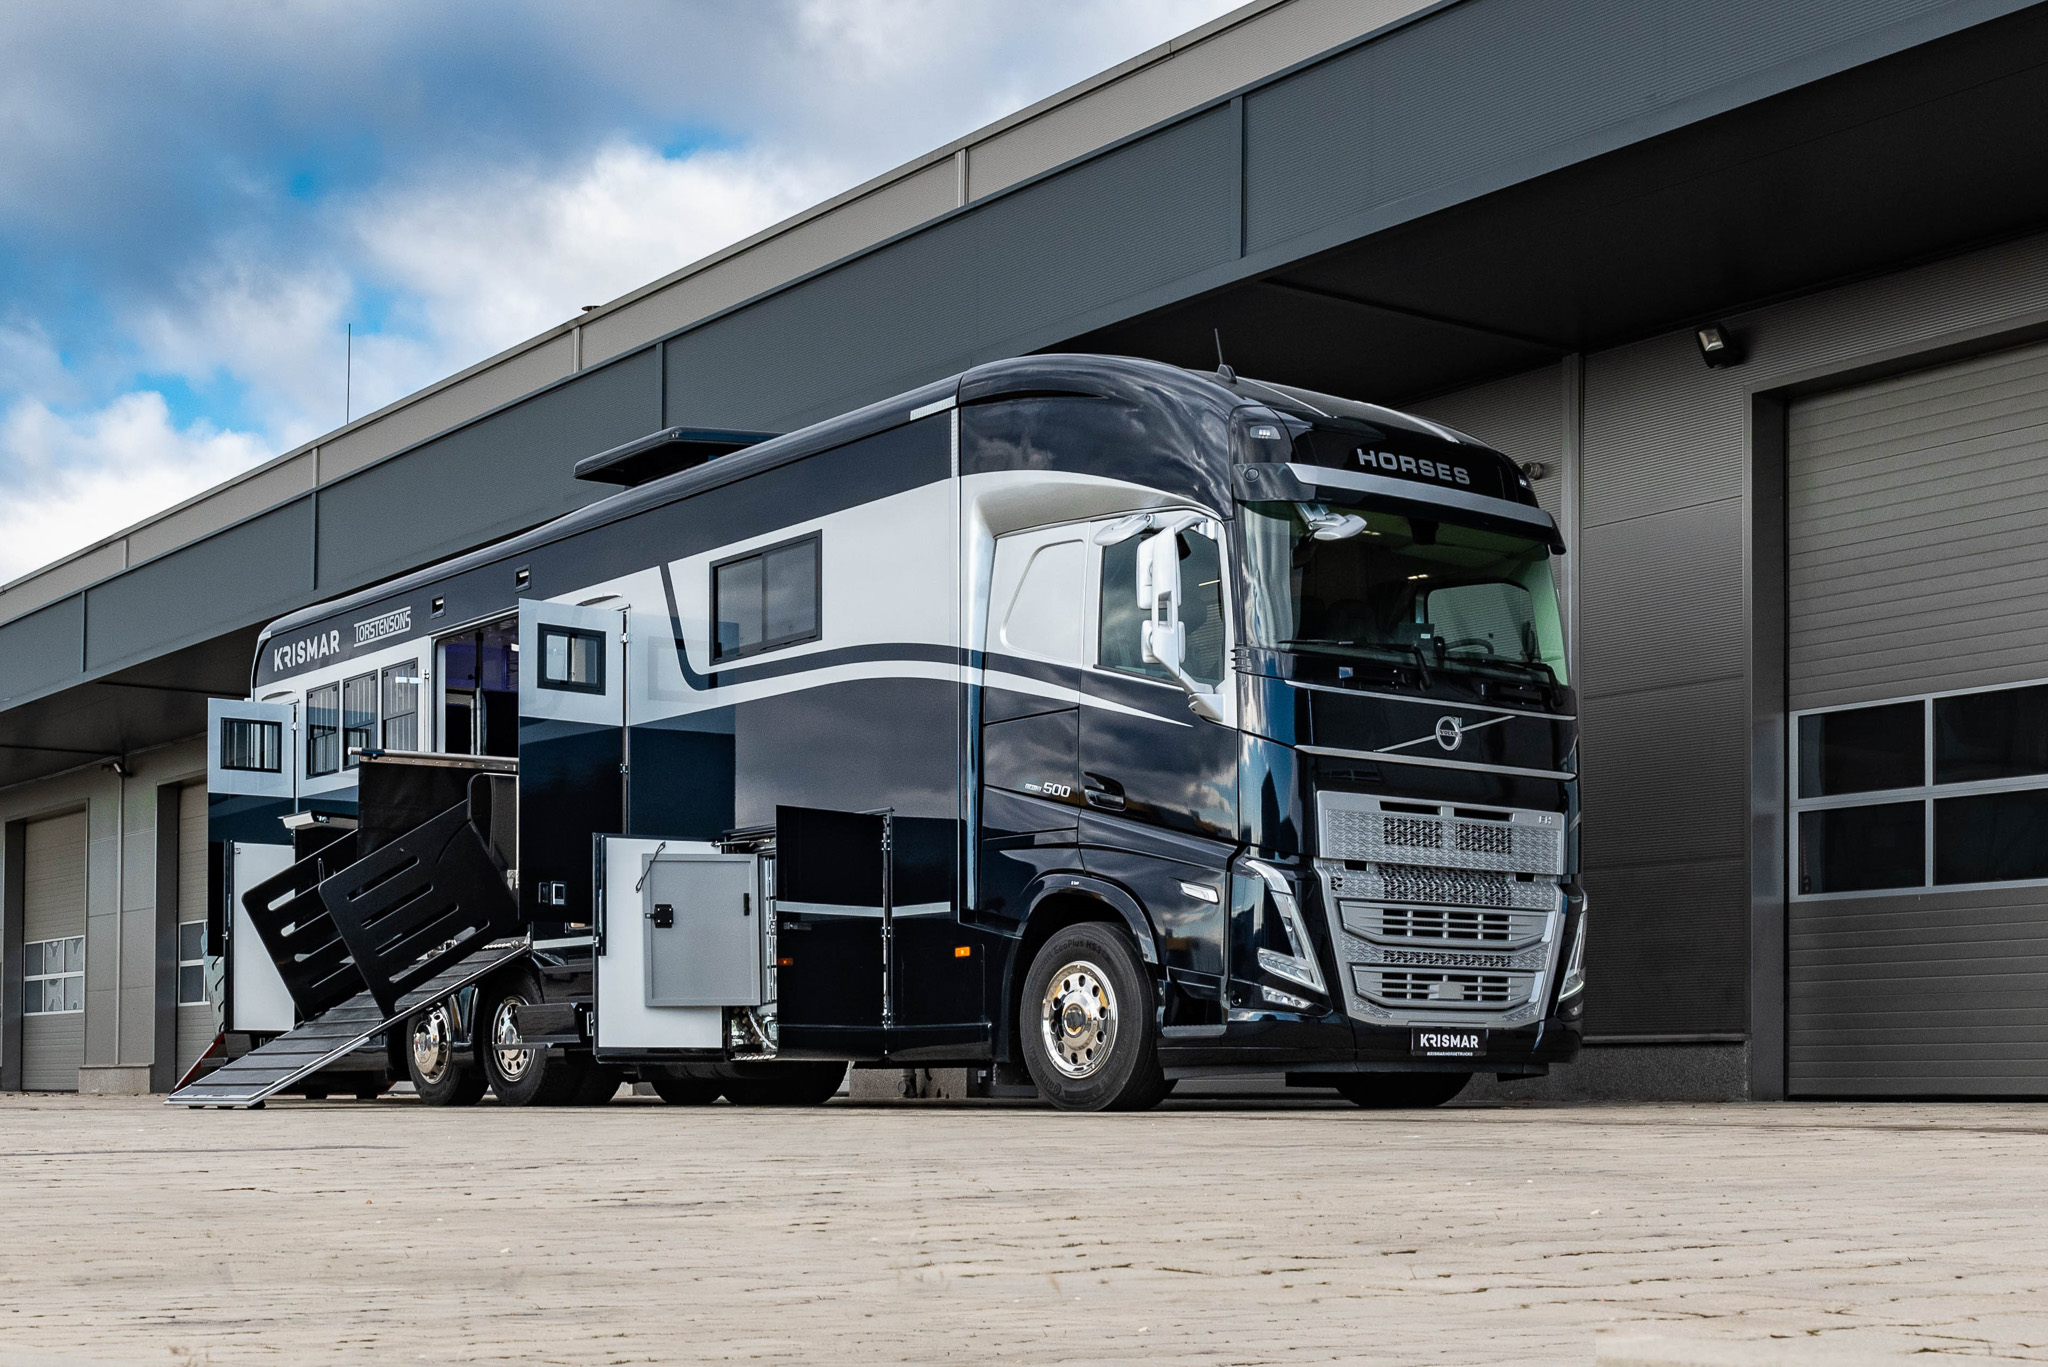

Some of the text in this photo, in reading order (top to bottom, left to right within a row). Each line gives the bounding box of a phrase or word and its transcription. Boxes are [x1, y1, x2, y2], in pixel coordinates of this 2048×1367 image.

[1356, 448, 1471, 485] HORSES
[353, 606, 412, 648] TORSTENSONS
[273, 629, 341, 672] KRISMAR
[1042, 782, 1071, 798] 500
[1053, 938, 1084, 955] EcoPlus
[1419, 1033, 1479, 1049] KRISMAR
